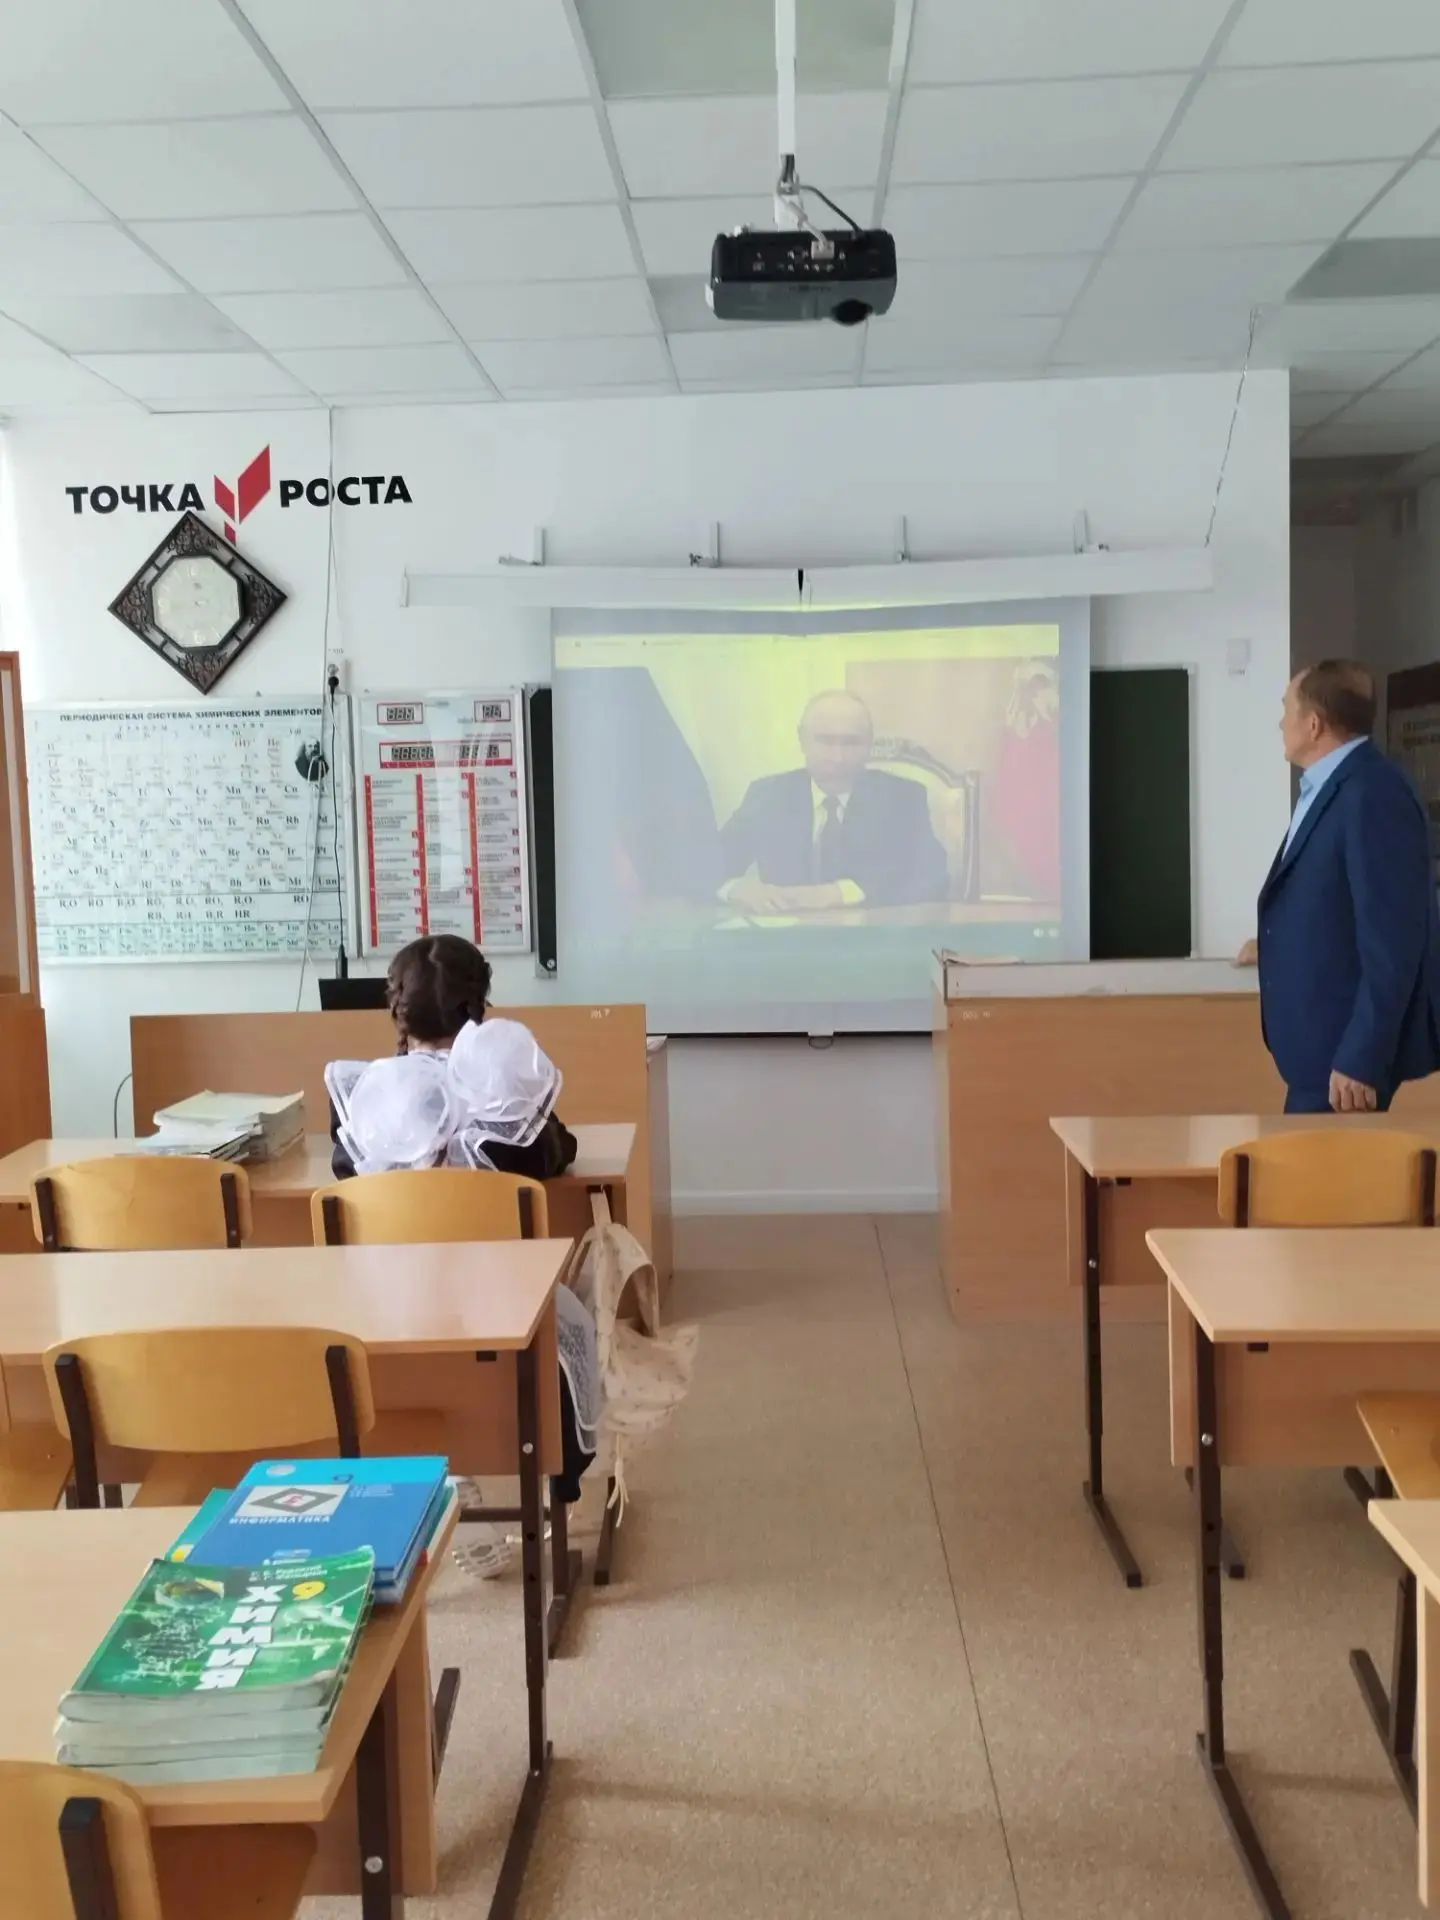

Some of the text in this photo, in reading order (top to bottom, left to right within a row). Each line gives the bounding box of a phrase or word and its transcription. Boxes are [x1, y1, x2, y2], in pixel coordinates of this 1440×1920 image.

[65, 475, 413, 515] ТОЧКА РОСТА
[60, 708, 322, 722] ПЕРИОДИЧЕСКАЯ СИСТЕМА ХИМИЧЕСКИХ ЭЛЕМЕНТОВ
[229, 1515, 331, 1525] ИНФОРМАТИКА
[292, 1580, 326, 1601] 9
[194, 1584, 288, 1691] ХИМИЯ
